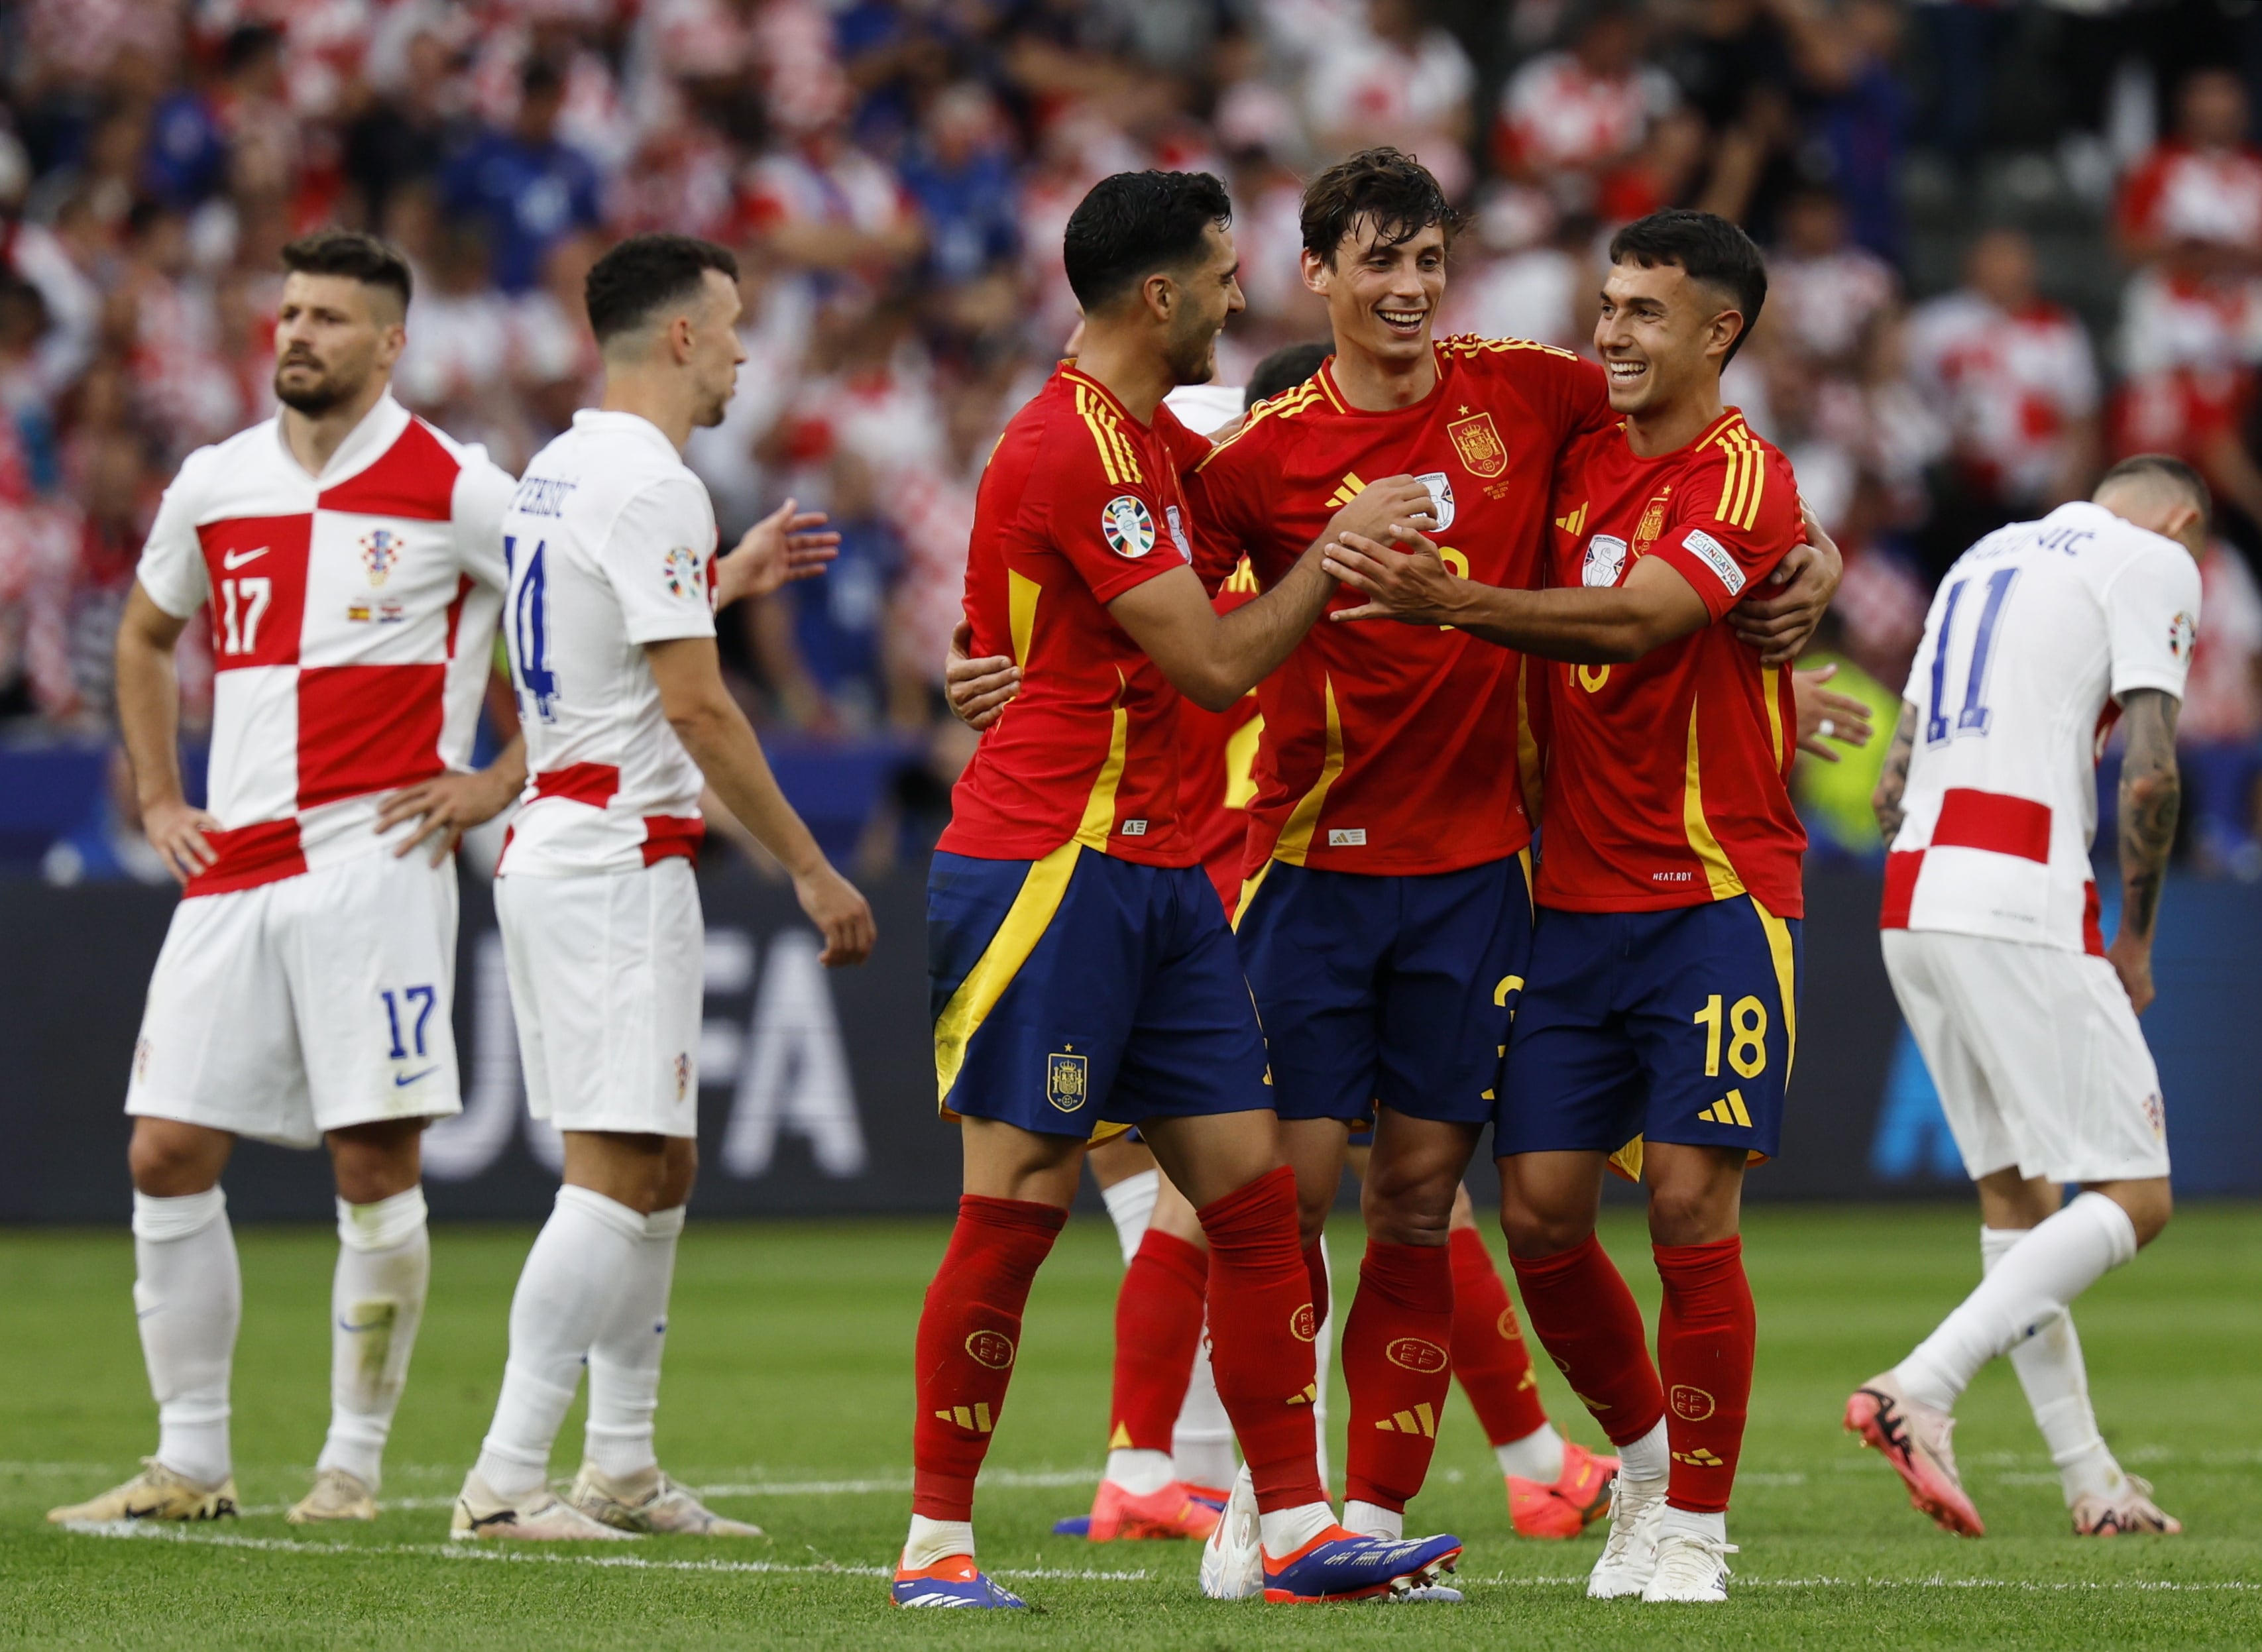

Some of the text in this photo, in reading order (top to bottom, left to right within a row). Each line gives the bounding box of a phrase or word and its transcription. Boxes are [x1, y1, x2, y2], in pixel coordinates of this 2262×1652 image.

[1689, 534, 1741, 589] FOUNDATION
[221, 576, 272, 656] 17
[1926, 567, 2021, 750] 11
[1652, 871, 1692, 881] HEAT.RDY
[382, 985, 437, 1061] 17
[1693, 994, 1768, 1079] 18
